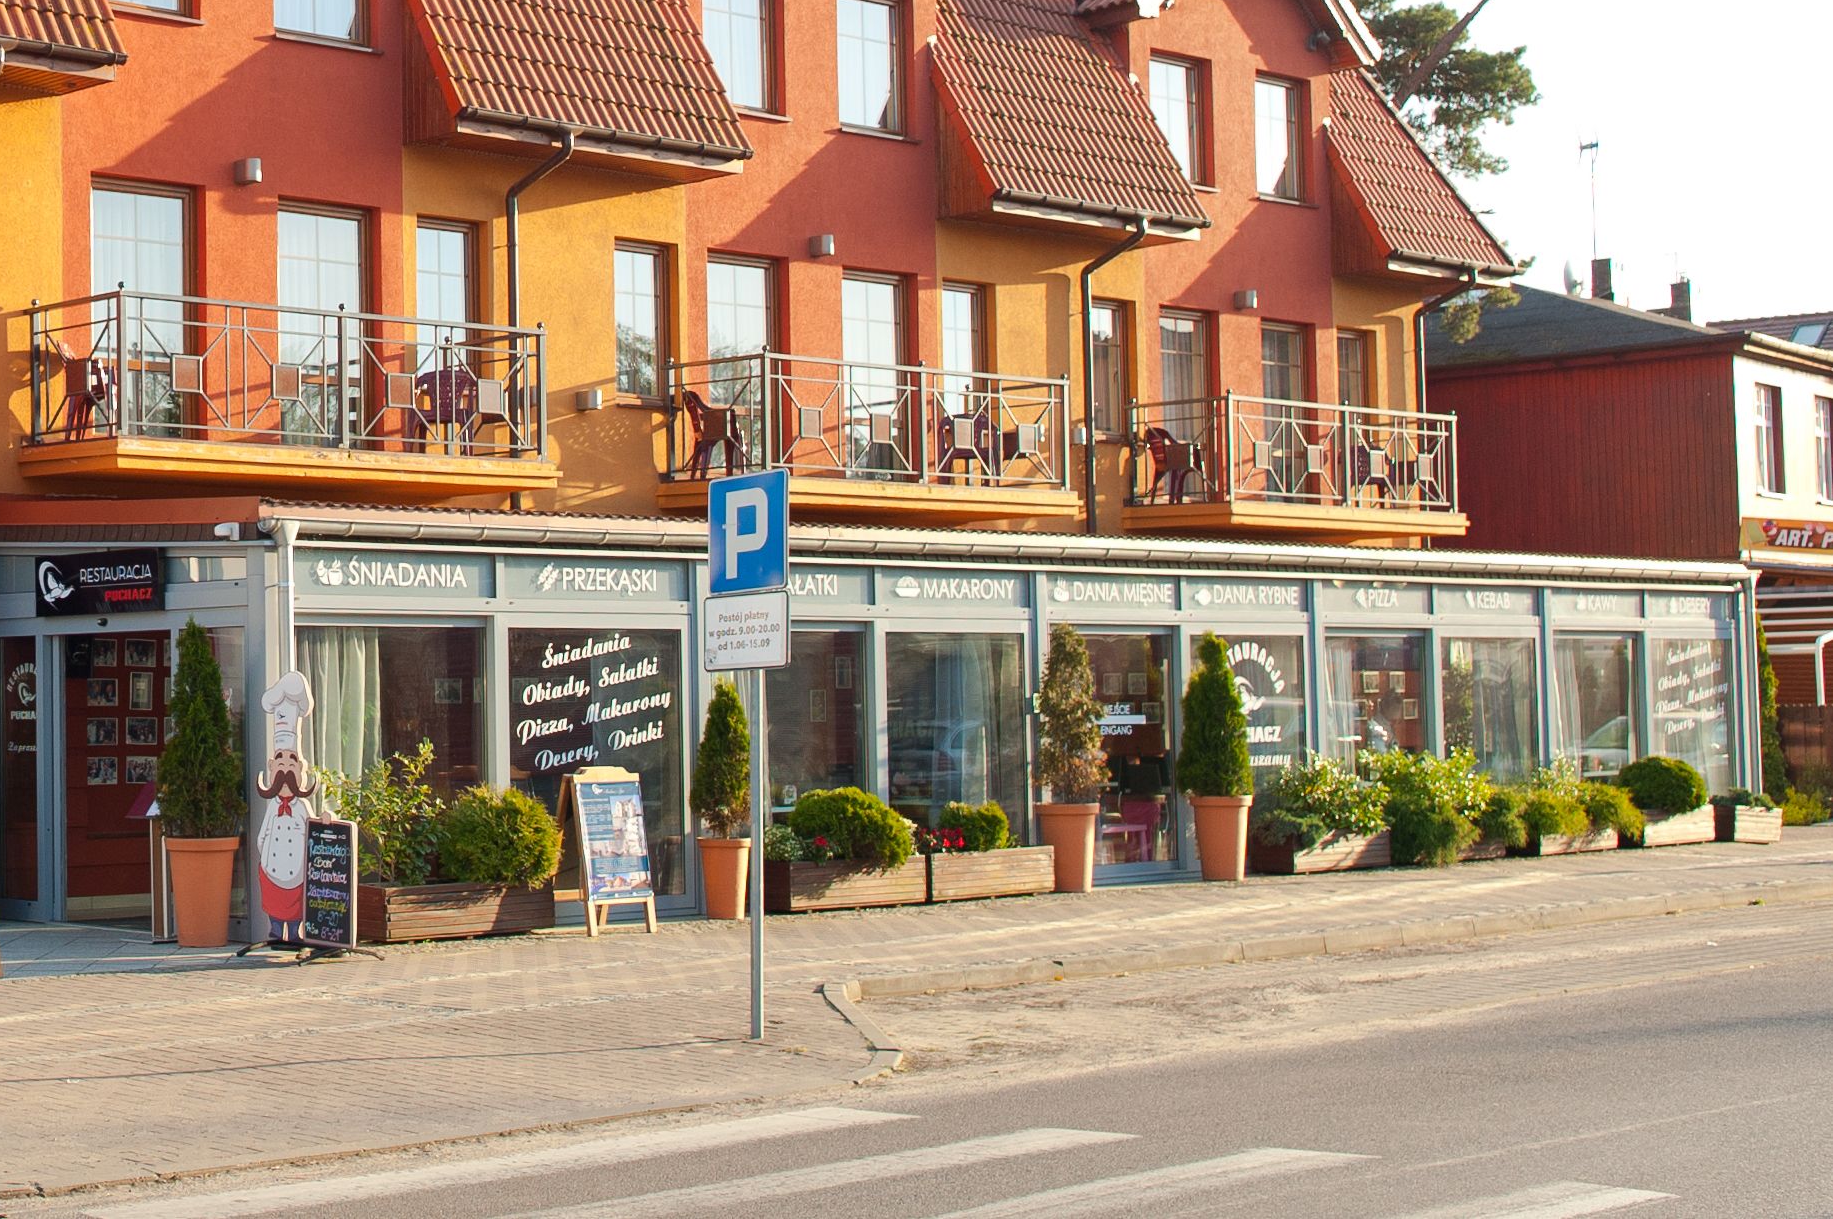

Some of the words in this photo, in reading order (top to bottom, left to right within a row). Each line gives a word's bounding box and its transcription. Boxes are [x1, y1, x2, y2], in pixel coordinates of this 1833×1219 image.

[726, 488, 768, 579] P
[1775, 529, 1814, 548] ART.
[79, 564, 152, 584] RESTAURACJA
[347, 554, 467, 588] ŚNIADANIA
[562, 567, 657, 596] PRZEKĄSKI
[786, 573, 839, 596] AŁATKI
[923, 578, 1014, 600] MAKARONY
[104, 587, 153, 603] PUCHACZ
[1072, 581, 1120, 602] DANIA
[1124, 583, 1172, 606] MIĘSNE
[1213, 585, 1256, 604] DANIA
[1259, 586, 1299, 605] RYBNE
[1368, 588, 1398, 608] PIZZA
[1476, 591, 1511, 609] KEBAB
[1587, 594, 1618, 611] KAWY
[1678, 597, 1712, 614] DESERY
[718, 612, 743, 623] Postój
[716, 626, 738, 639] godz.
[738, 623, 781, 636] 9.00-20.00
[542, 633, 632, 669] Śniadania
[718, 642, 728, 651] od
[7, 663, 37, 692] RESTAUR
[1225, 642, 1285, 694] TAURACJA
[523, 675, 591, 706] Obiady,
[599, 657, 659, 688] Sałatki
[11, 711, 37, 720] PUCHA
[517, 717, 574, 746] Pizza,
[582, 691, 672, 726] Makarony
[1246, 726, 1282, 743] HACZ
[535, 744, 600, 771] Desery,
[608, 720, 665, 751] Drinki
